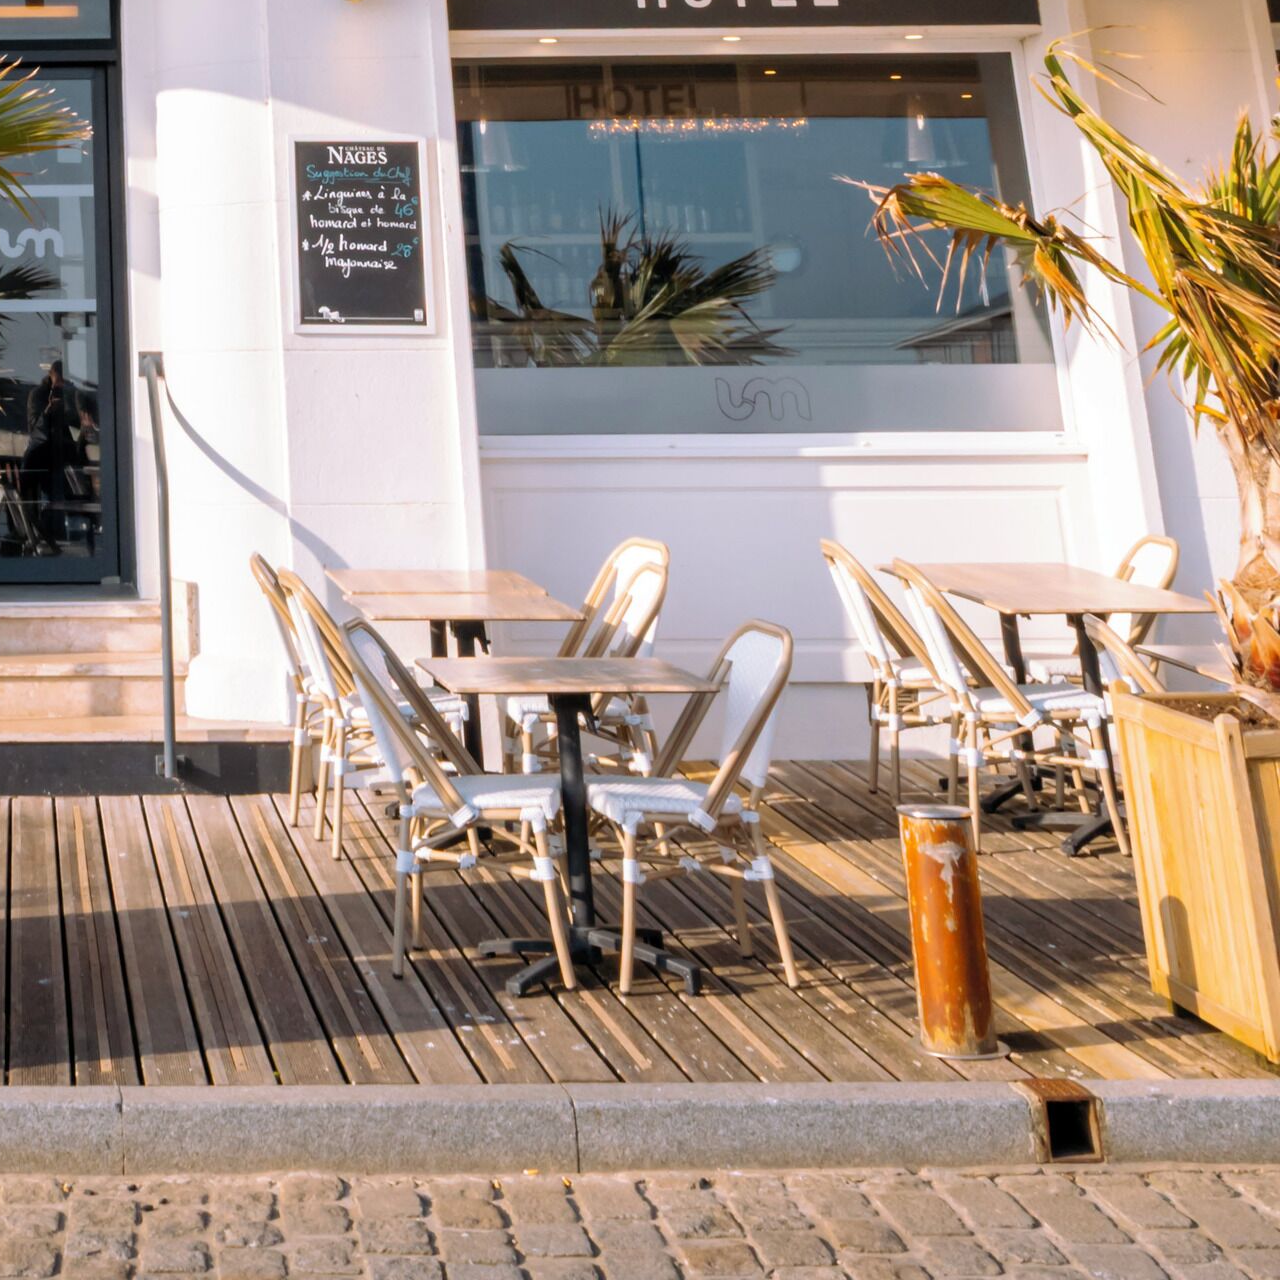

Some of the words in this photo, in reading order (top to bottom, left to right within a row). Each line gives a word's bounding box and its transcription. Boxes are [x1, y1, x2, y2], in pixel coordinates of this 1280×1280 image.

[326, 146, 388, 165] NAGES
[377, 185, 385, 199] à
[391, 187, 407, 200] la
[328, 202, 364, 218] bisque
[370, 204, 385, 214] de
[309, 214, 358, 229] homard
[361, 218, 372, 228] et
[377, 217, 417, 229] homard
[312, 234, 335, 256] 1/2
[338, 233, 388, 252] homard
[325, 256, 398, 279] mayonnaise
